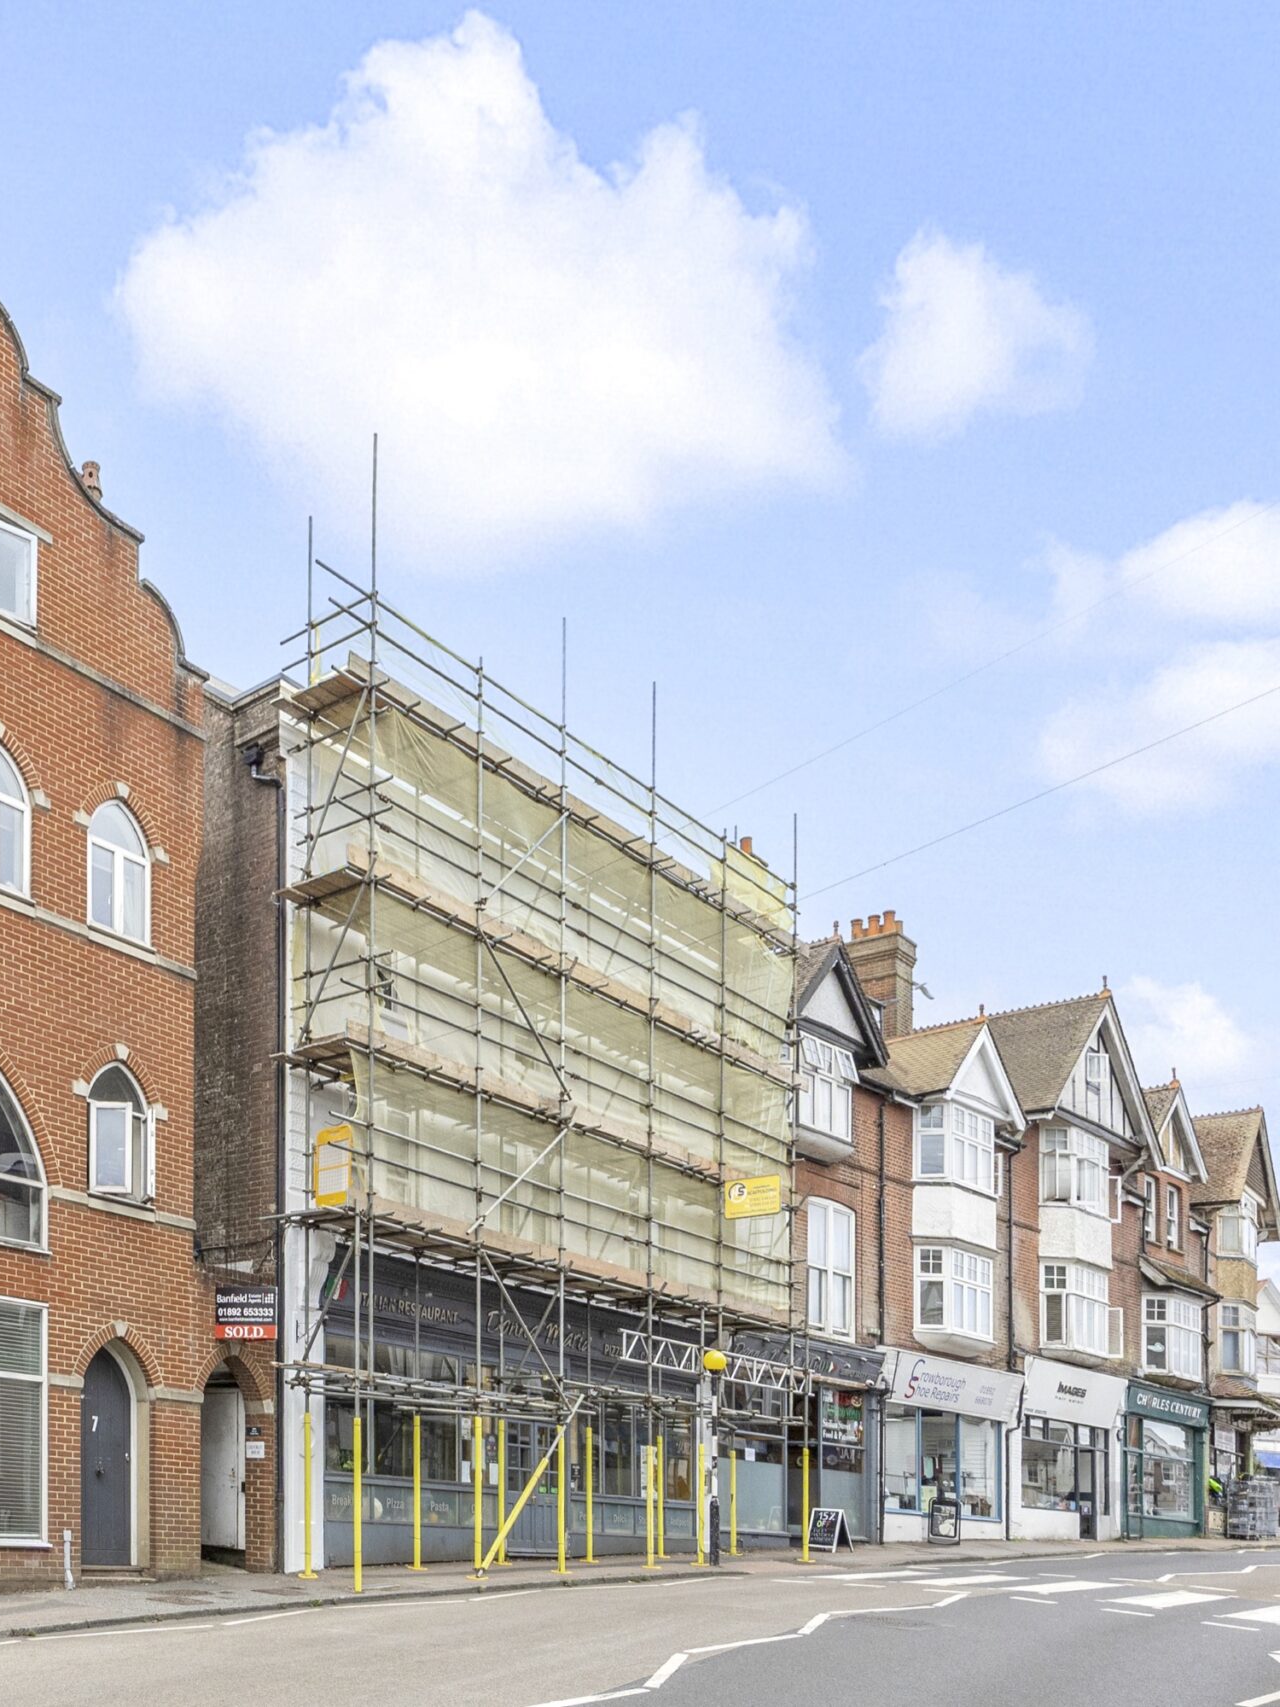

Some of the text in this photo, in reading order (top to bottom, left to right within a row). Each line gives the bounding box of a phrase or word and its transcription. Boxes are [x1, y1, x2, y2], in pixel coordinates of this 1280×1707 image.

[216, 1293, 247, 1304] Banfield
[218, 1307, 273, 1316] 01892 653333
[398, 1300, 459, 1324] RESTAURANT
[224, 1325, 264, 1338] SOLD
[604, 1344, 624, 1358] PIZZ
[911, 1359, 967, 1392] Crowborough
[904, 1376, 960, 1404] Shoe Repairs
[1170, 1402, 1202, 1419] CENTURY
[91, 1415, 99, 1432] 7
[387, 1498, 405, 1509] Pizza
[431, 1500, 449, 1512] Pasta
[818, 1511, 836, 1520] 15%
